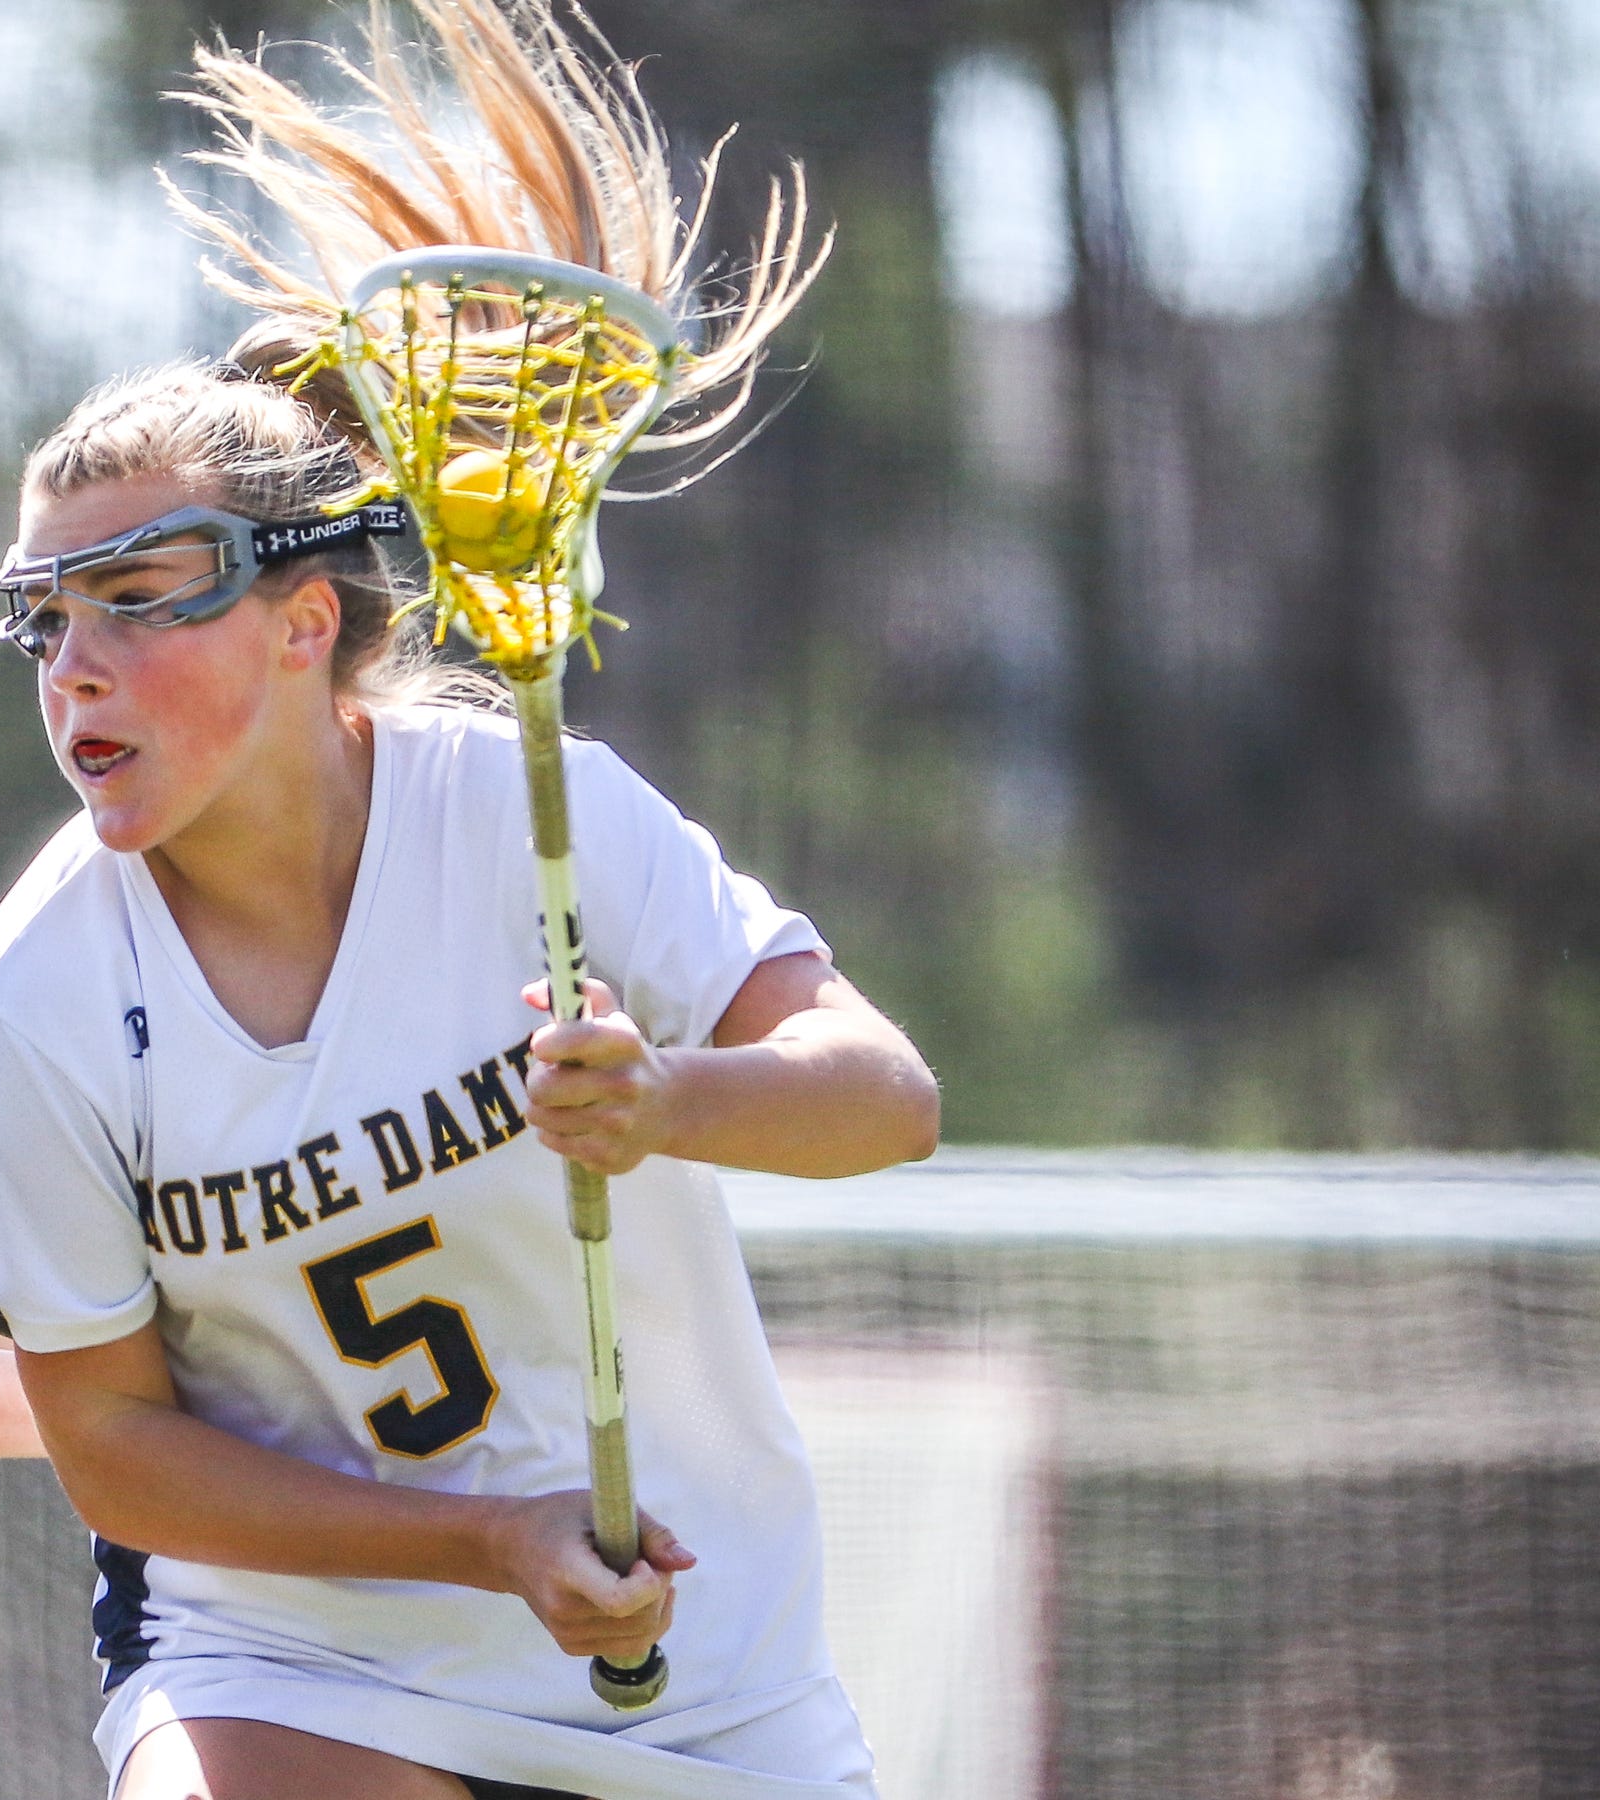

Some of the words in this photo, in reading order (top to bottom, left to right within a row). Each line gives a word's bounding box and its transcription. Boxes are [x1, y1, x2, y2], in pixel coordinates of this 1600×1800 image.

[300, 514, 361, 543] UNDER
[359, 1031, 534, 1196] DAM
[299, 1213, 501, 1462] 5
